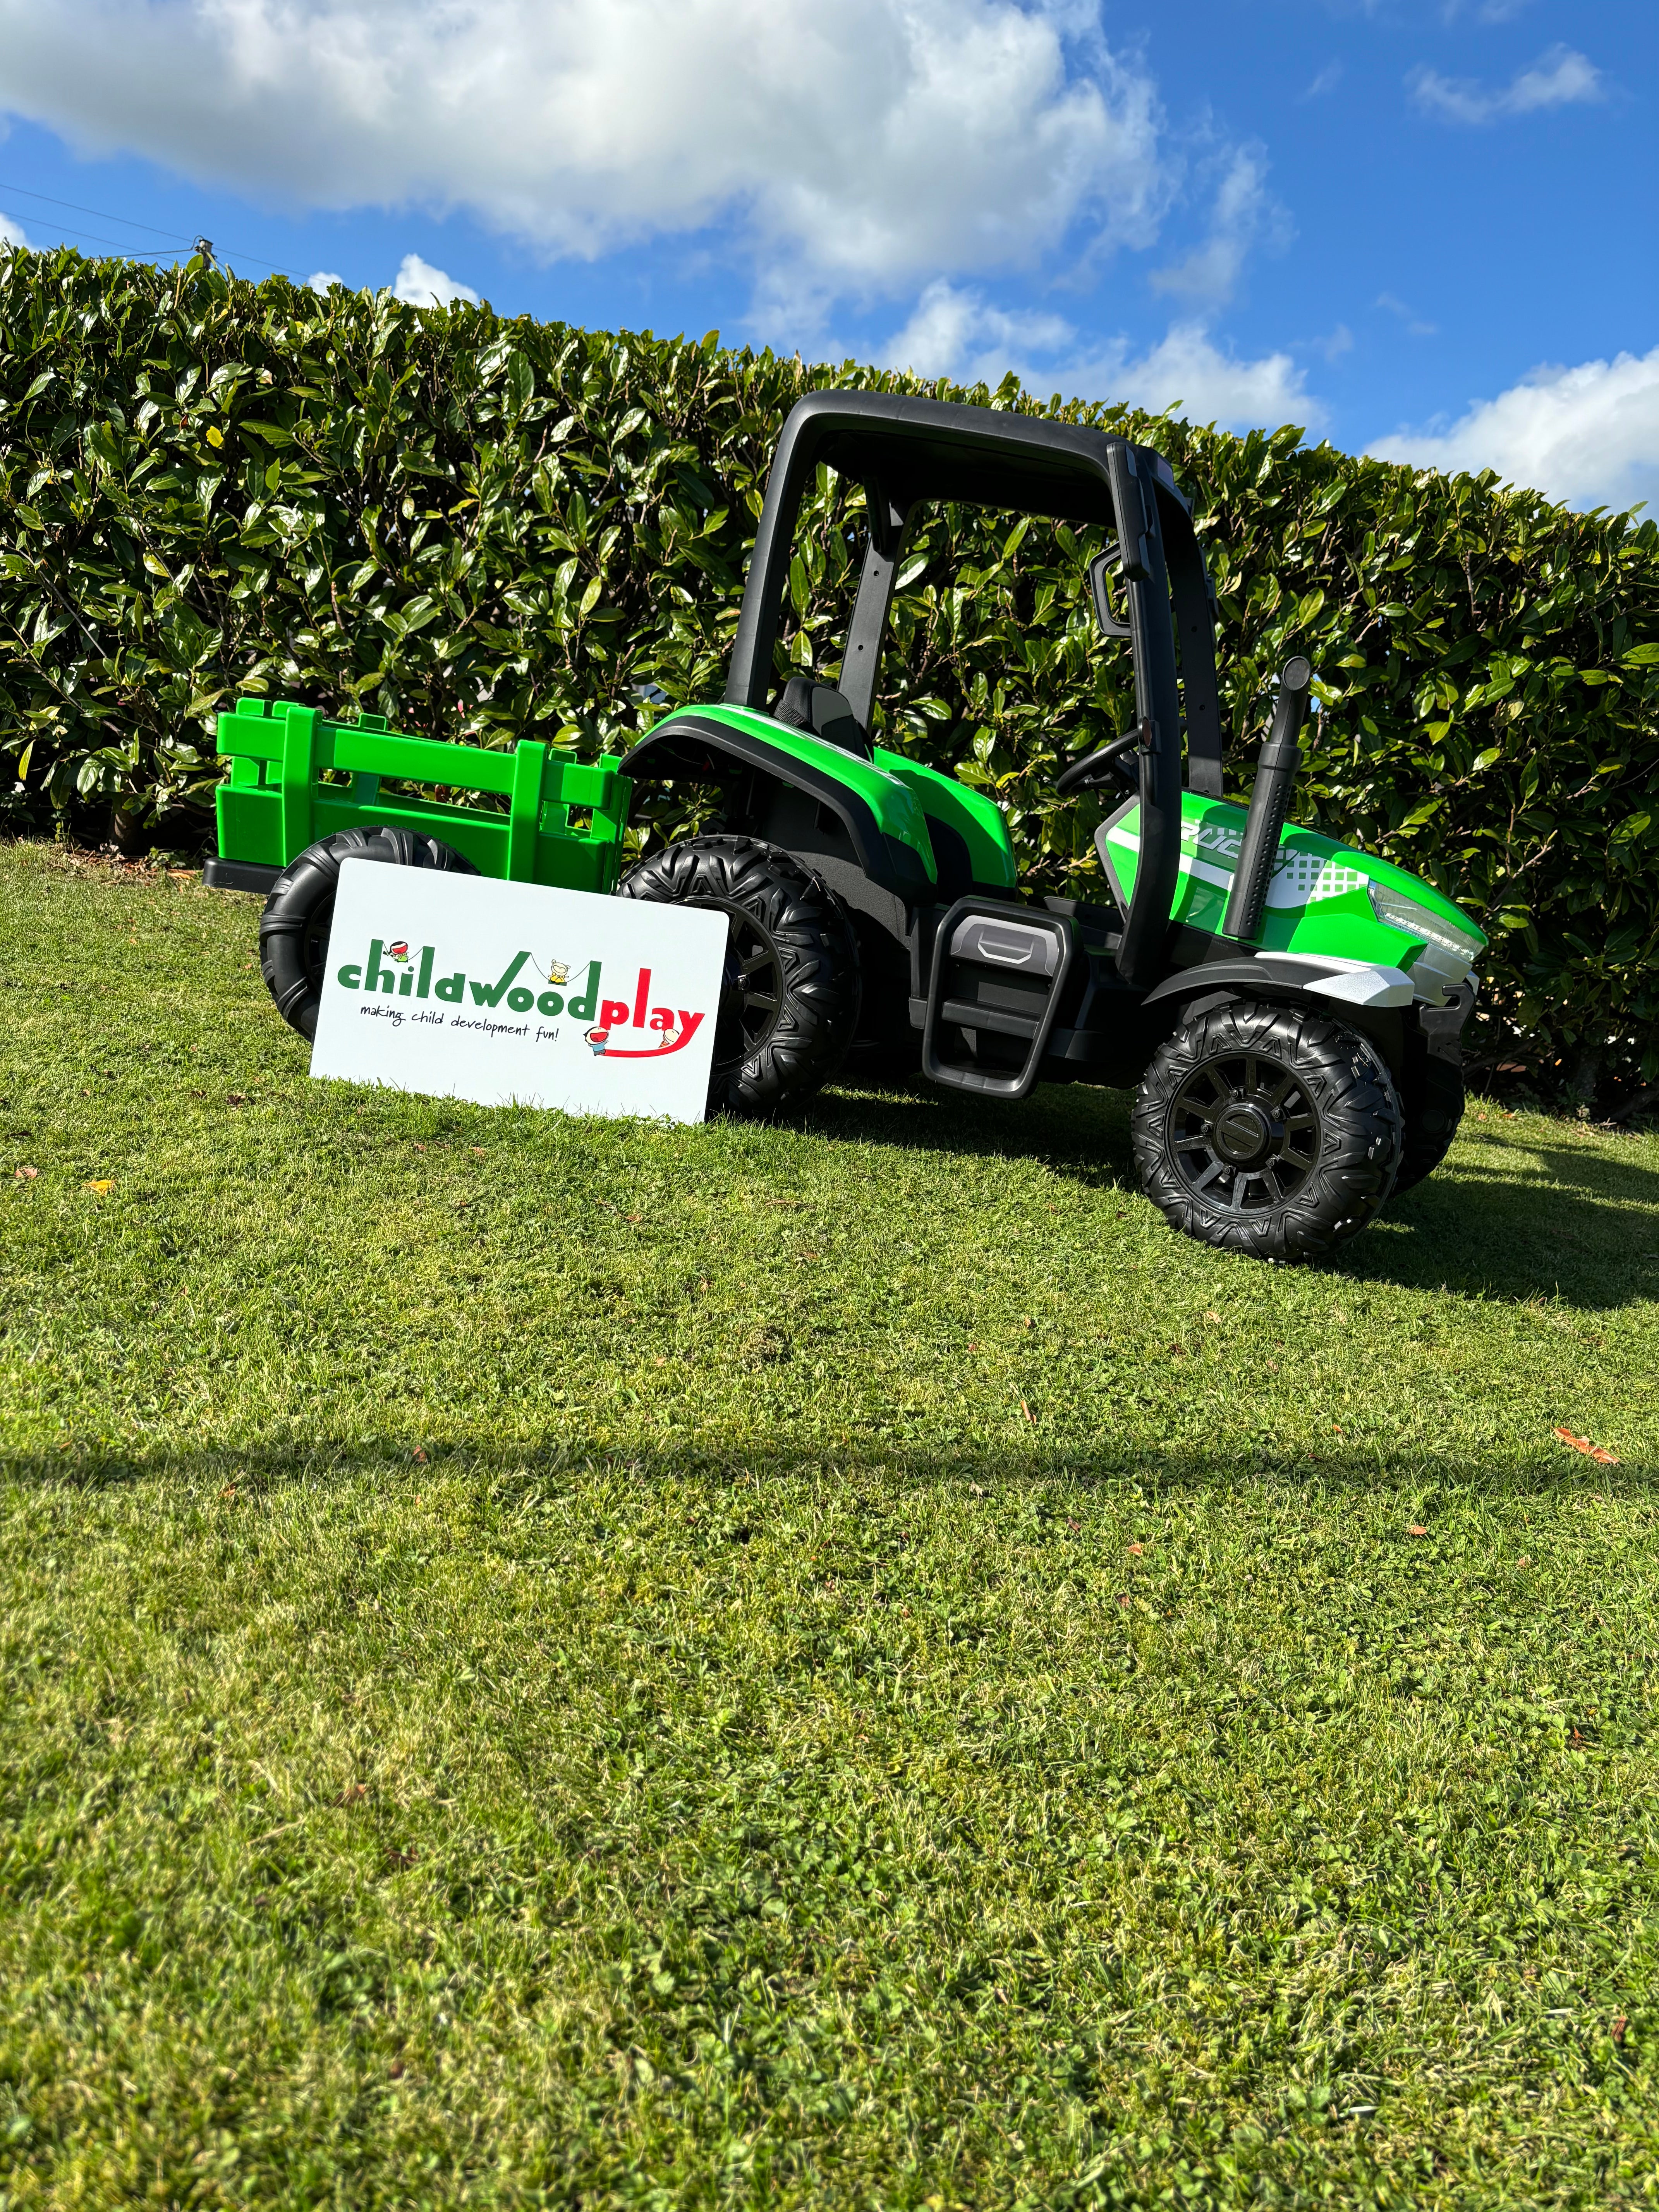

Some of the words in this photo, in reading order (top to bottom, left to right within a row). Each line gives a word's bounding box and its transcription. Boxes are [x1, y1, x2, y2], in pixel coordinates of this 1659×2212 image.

[337, 939, 705, 1058] childwoodplay
[360, 1005, 406, 1027] making
[411, 1011, 444, 1024] child
[451, 1015, 530, 1038] development
[536, 1026, 559, 1042] fun!
